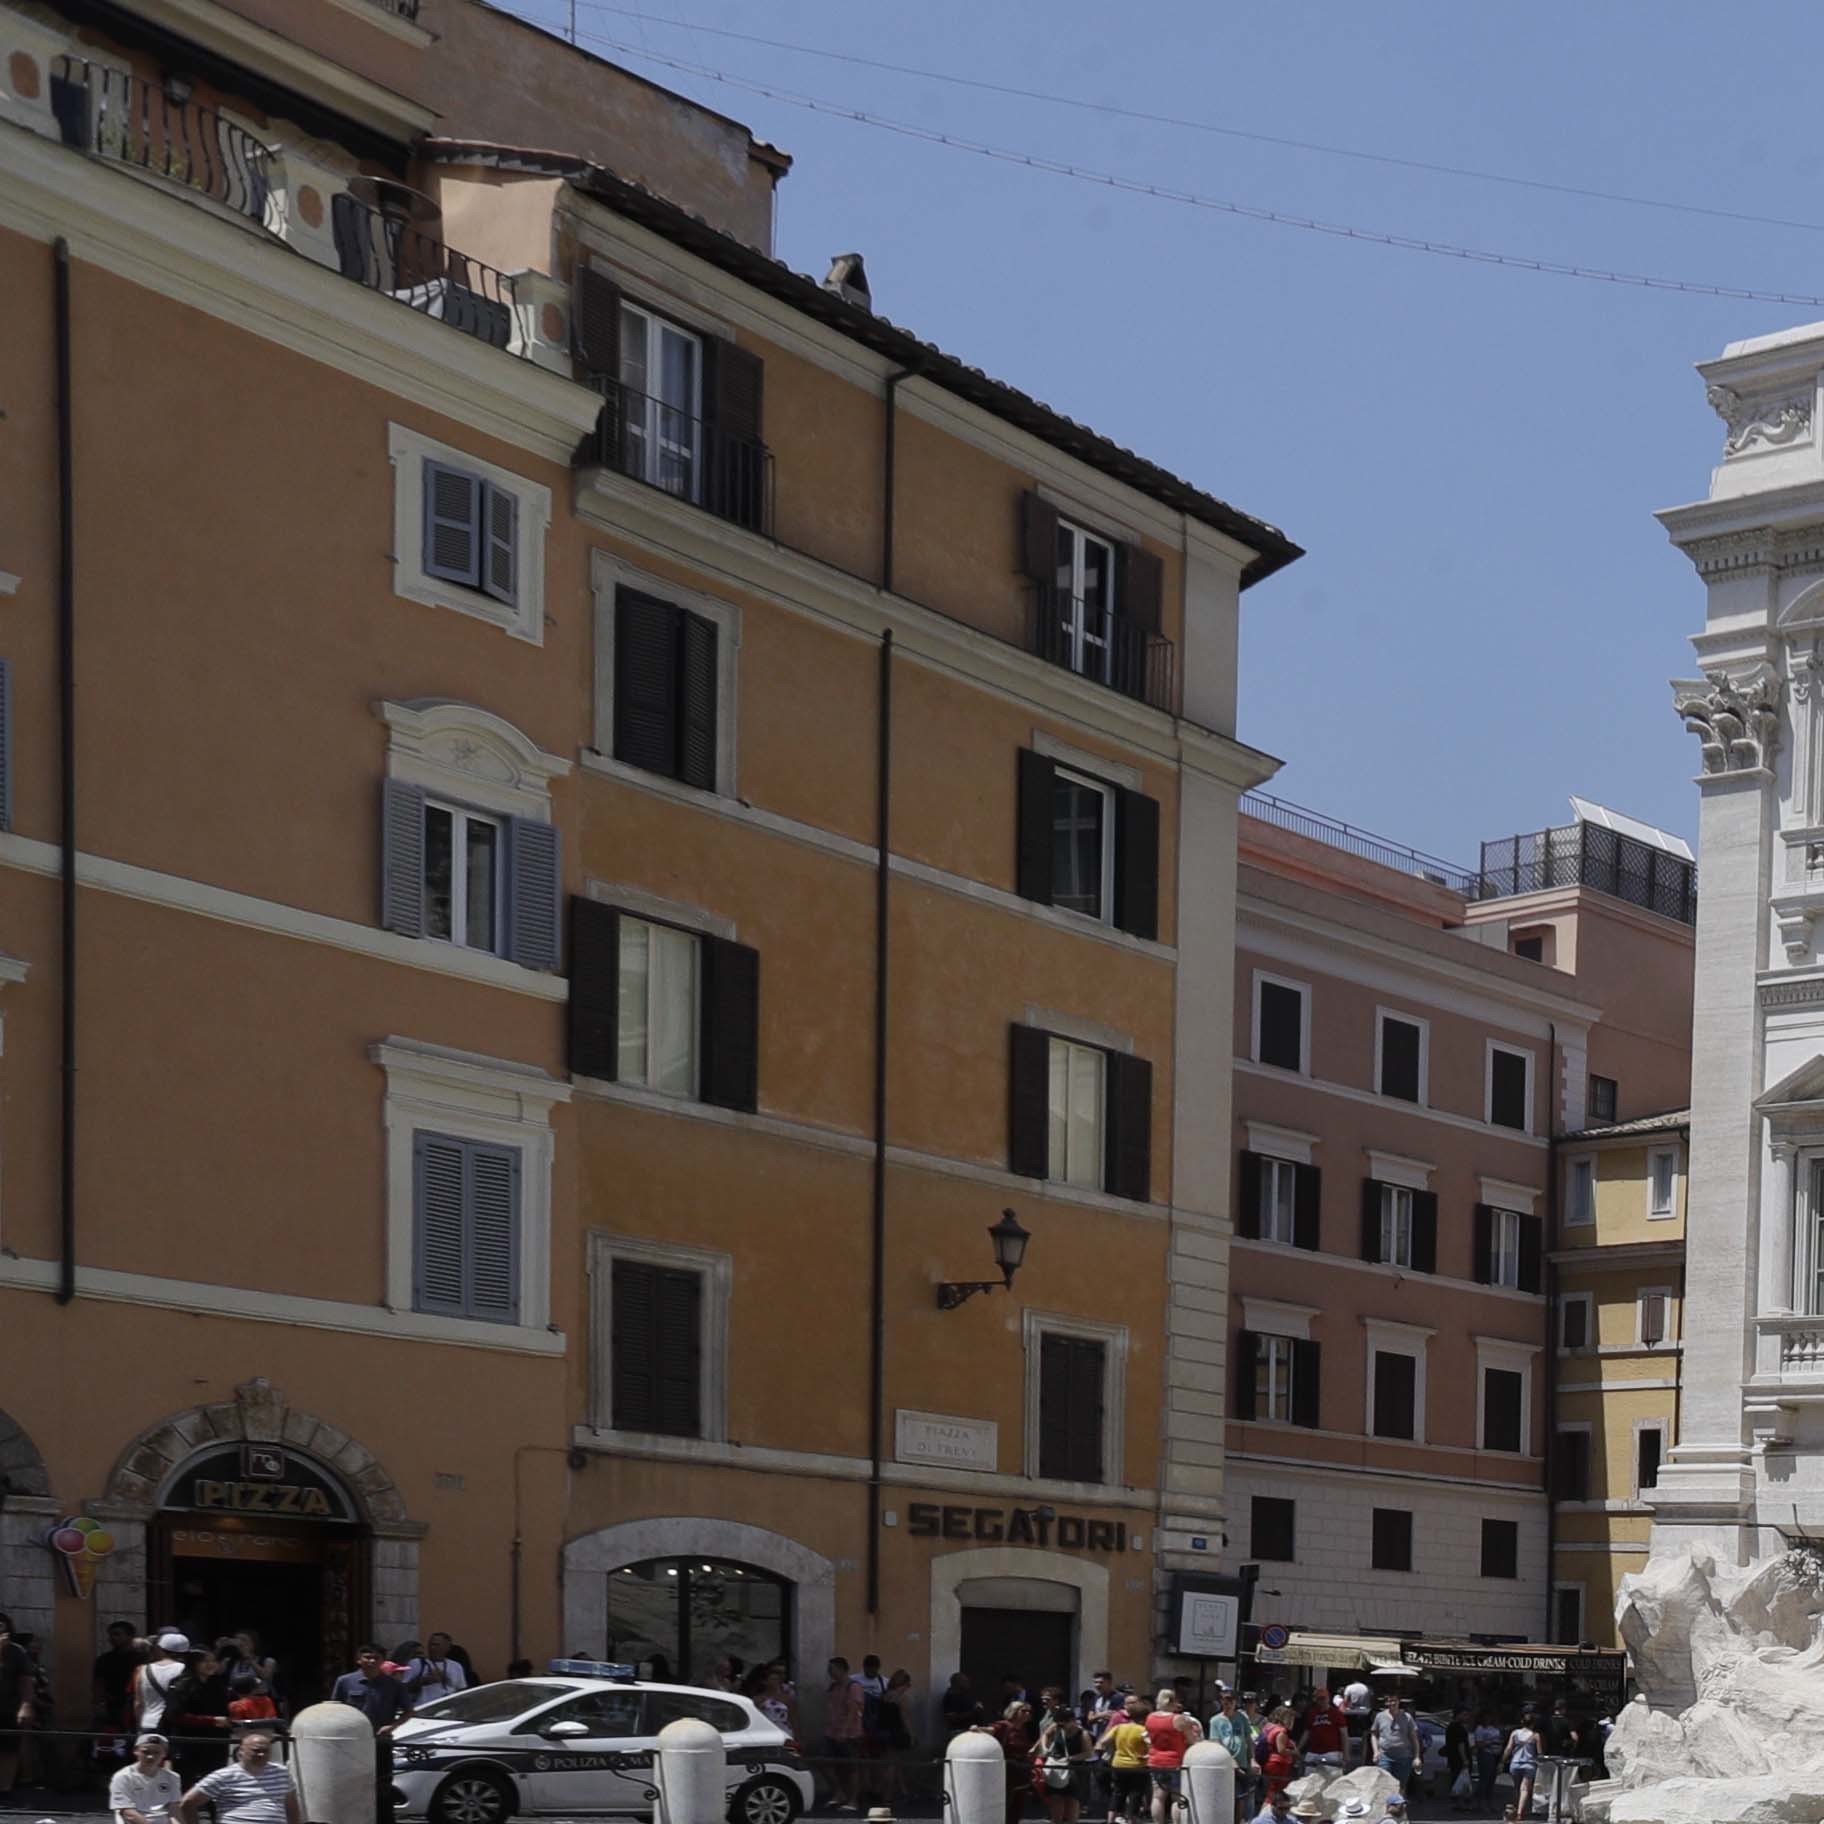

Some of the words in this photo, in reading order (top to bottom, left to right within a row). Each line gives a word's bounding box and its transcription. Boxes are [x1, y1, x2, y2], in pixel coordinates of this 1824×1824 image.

[194, 1479, 331, 1516] PIZZA
[908, 1502, 1127, 1552] SEGATORI
[554, 1756, 608, 1770] POLIZIA
